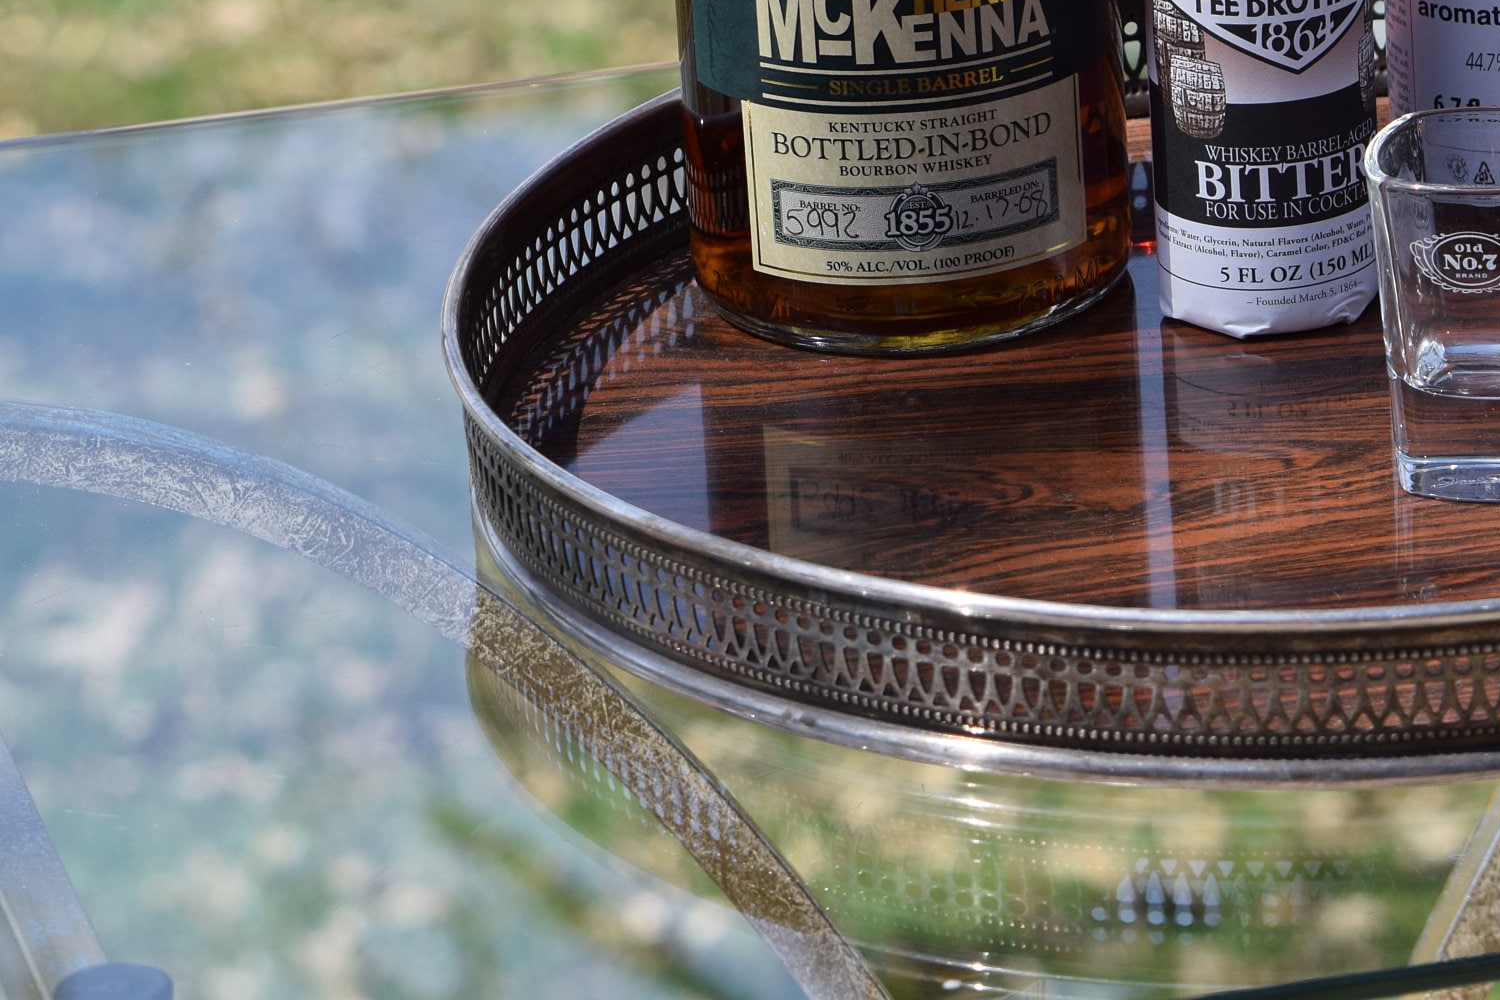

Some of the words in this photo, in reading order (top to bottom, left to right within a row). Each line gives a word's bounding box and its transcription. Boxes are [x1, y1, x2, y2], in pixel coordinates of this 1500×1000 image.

[1249, 14, 1327, 56] 1864
[828, 78, 910, 97] SINGLE
[916, 66, 1004, 94] BARREL
[828, 120, 916, 134] KENTUCKY
[920, 108, 998, 130] STRAIGHT
[771, 112, 1051, 162] BOTTLED-IN-BOND
[1204, 144, 1286, 163] WHISKEY
[1286, 117, 1373, 161] BARREL-AGED
[839, 163, 918, 177] BOURBON
[922, 154, 993, 174] WHISKEY
[1194, 140, 1369, 203] BITTER
[799, 200, 840, 211] BARREL
[970, 186, 1022, 204] BARRELED
[1205, 201, 1241, 220] FOR
[1244, 203, 1277, 221] USE
[1283, 200, 1303, 218] IN
[1308, 183, 1367, 216] COCKTA
[885, 206, 951, 237] 1855
[1180, 228, 1201, 242] Water,
[1203, 235, 1240, 247] Glycerin,
[1242, 239, 1275, 248] Natural
[1278, 236, 1309, 246] Flavors
[1311, 226, 1345, 242] (Alcohol,
[826, 260, 853, 272] 50%
[856, 259, 931, 274] ALC./VOL.
[933, 256, 961, 271] (100
[963, 244, 1015, 267] PROOF)
[1194, 244, 1228, 258] (Alcohol,
[1231, 249, 1264, 260] Flavor),
[1266, 246, 1302, 258] Caramel
[1304, 242, 1330, 254] Color,
[1332, 232, 1355, 248] FD&C
[1355, 227, 1367, 239] Red
[1454, 243, 1484, 253] Old
[1220, 266, 1230, 283] 5
[1238, 267, 1264, 284] FL
[1270, 264, 1303, 283] OZ
[1309, 255, 1347, 281] (150
[1350, 240, 1374, 267] ML)
[1256, 294, 1297, 306] Founded
[1299, 288, 1328, 303] March
[1329, 287, 1337, 297] 5,
